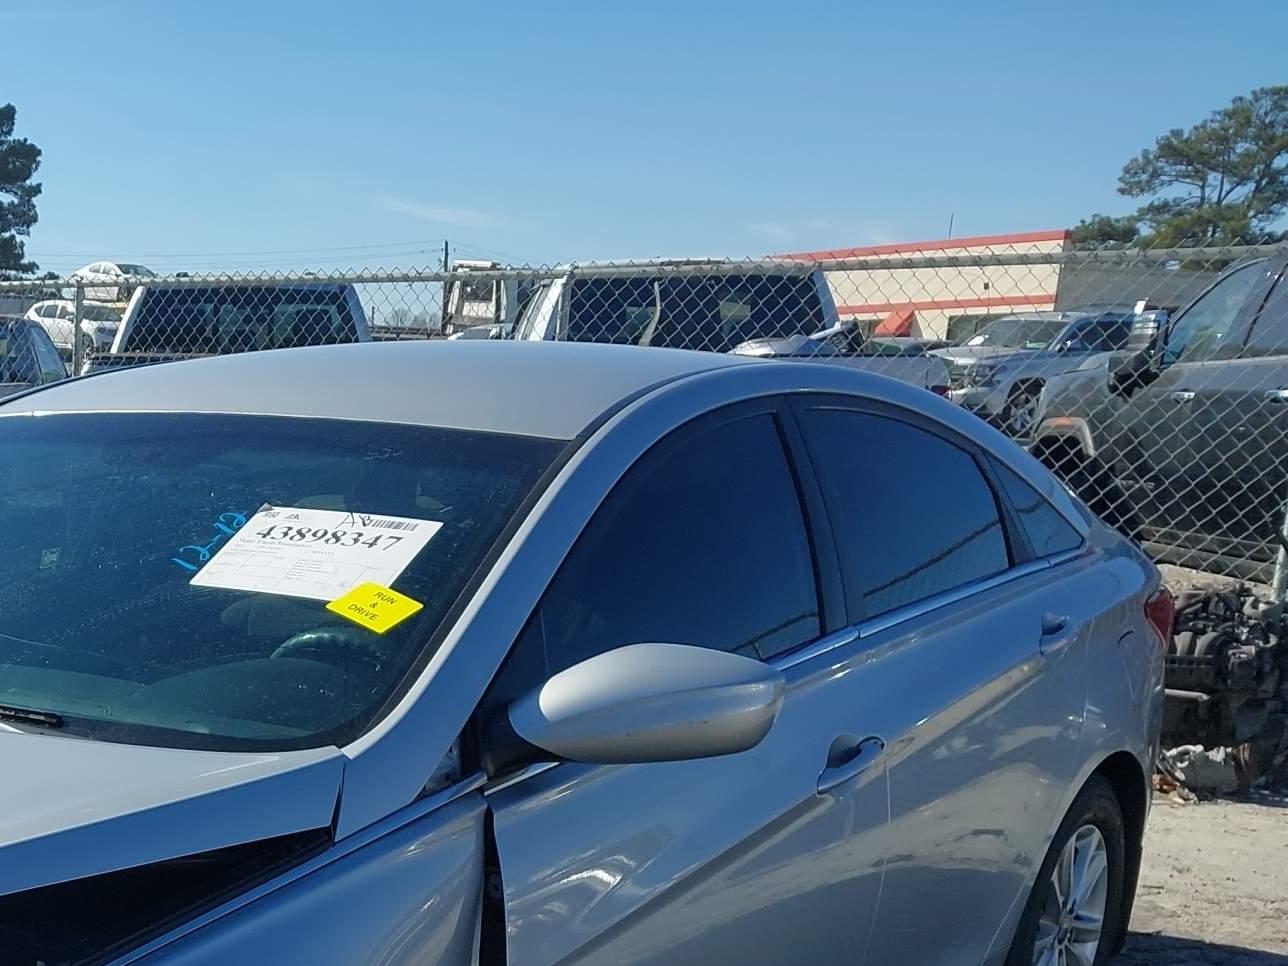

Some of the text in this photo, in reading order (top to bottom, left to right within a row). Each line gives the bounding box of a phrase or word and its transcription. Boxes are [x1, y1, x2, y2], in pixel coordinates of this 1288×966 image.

[255, 524, 405, 551] 43898347
[369, 601, 379, 609] &
[374, 591, 398, 605] RUN
[347, 603, 379, 621] DRIVE
